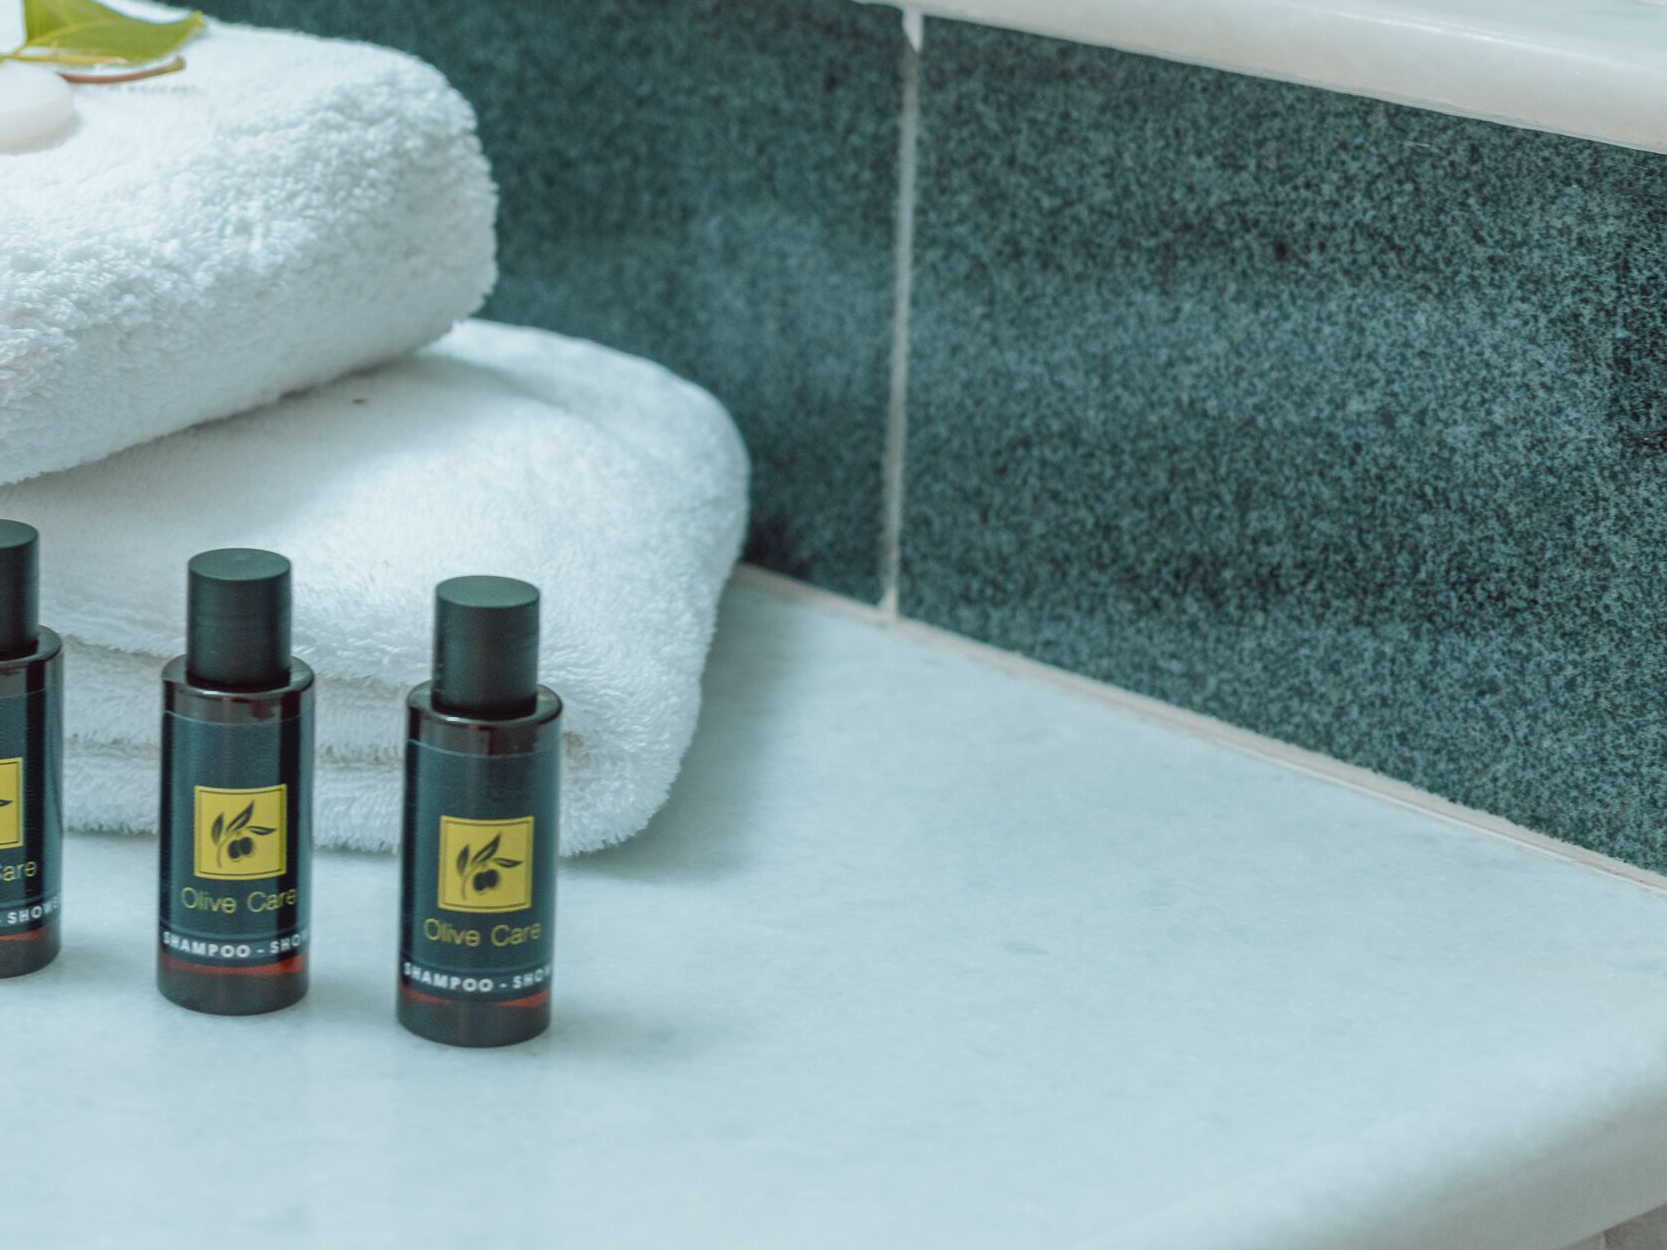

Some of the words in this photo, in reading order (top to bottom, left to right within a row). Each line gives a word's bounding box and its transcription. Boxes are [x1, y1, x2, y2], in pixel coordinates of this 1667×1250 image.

[181, 886, 236, 914] Olive
[246, 888, 296, 913] Care
[163, 931, 250, 958] SHAMPOO
[424, 918, 480, 948] Olive
[490, 922, 541, 947] Care
[404, 962, 493, 992] SHAMPOO
